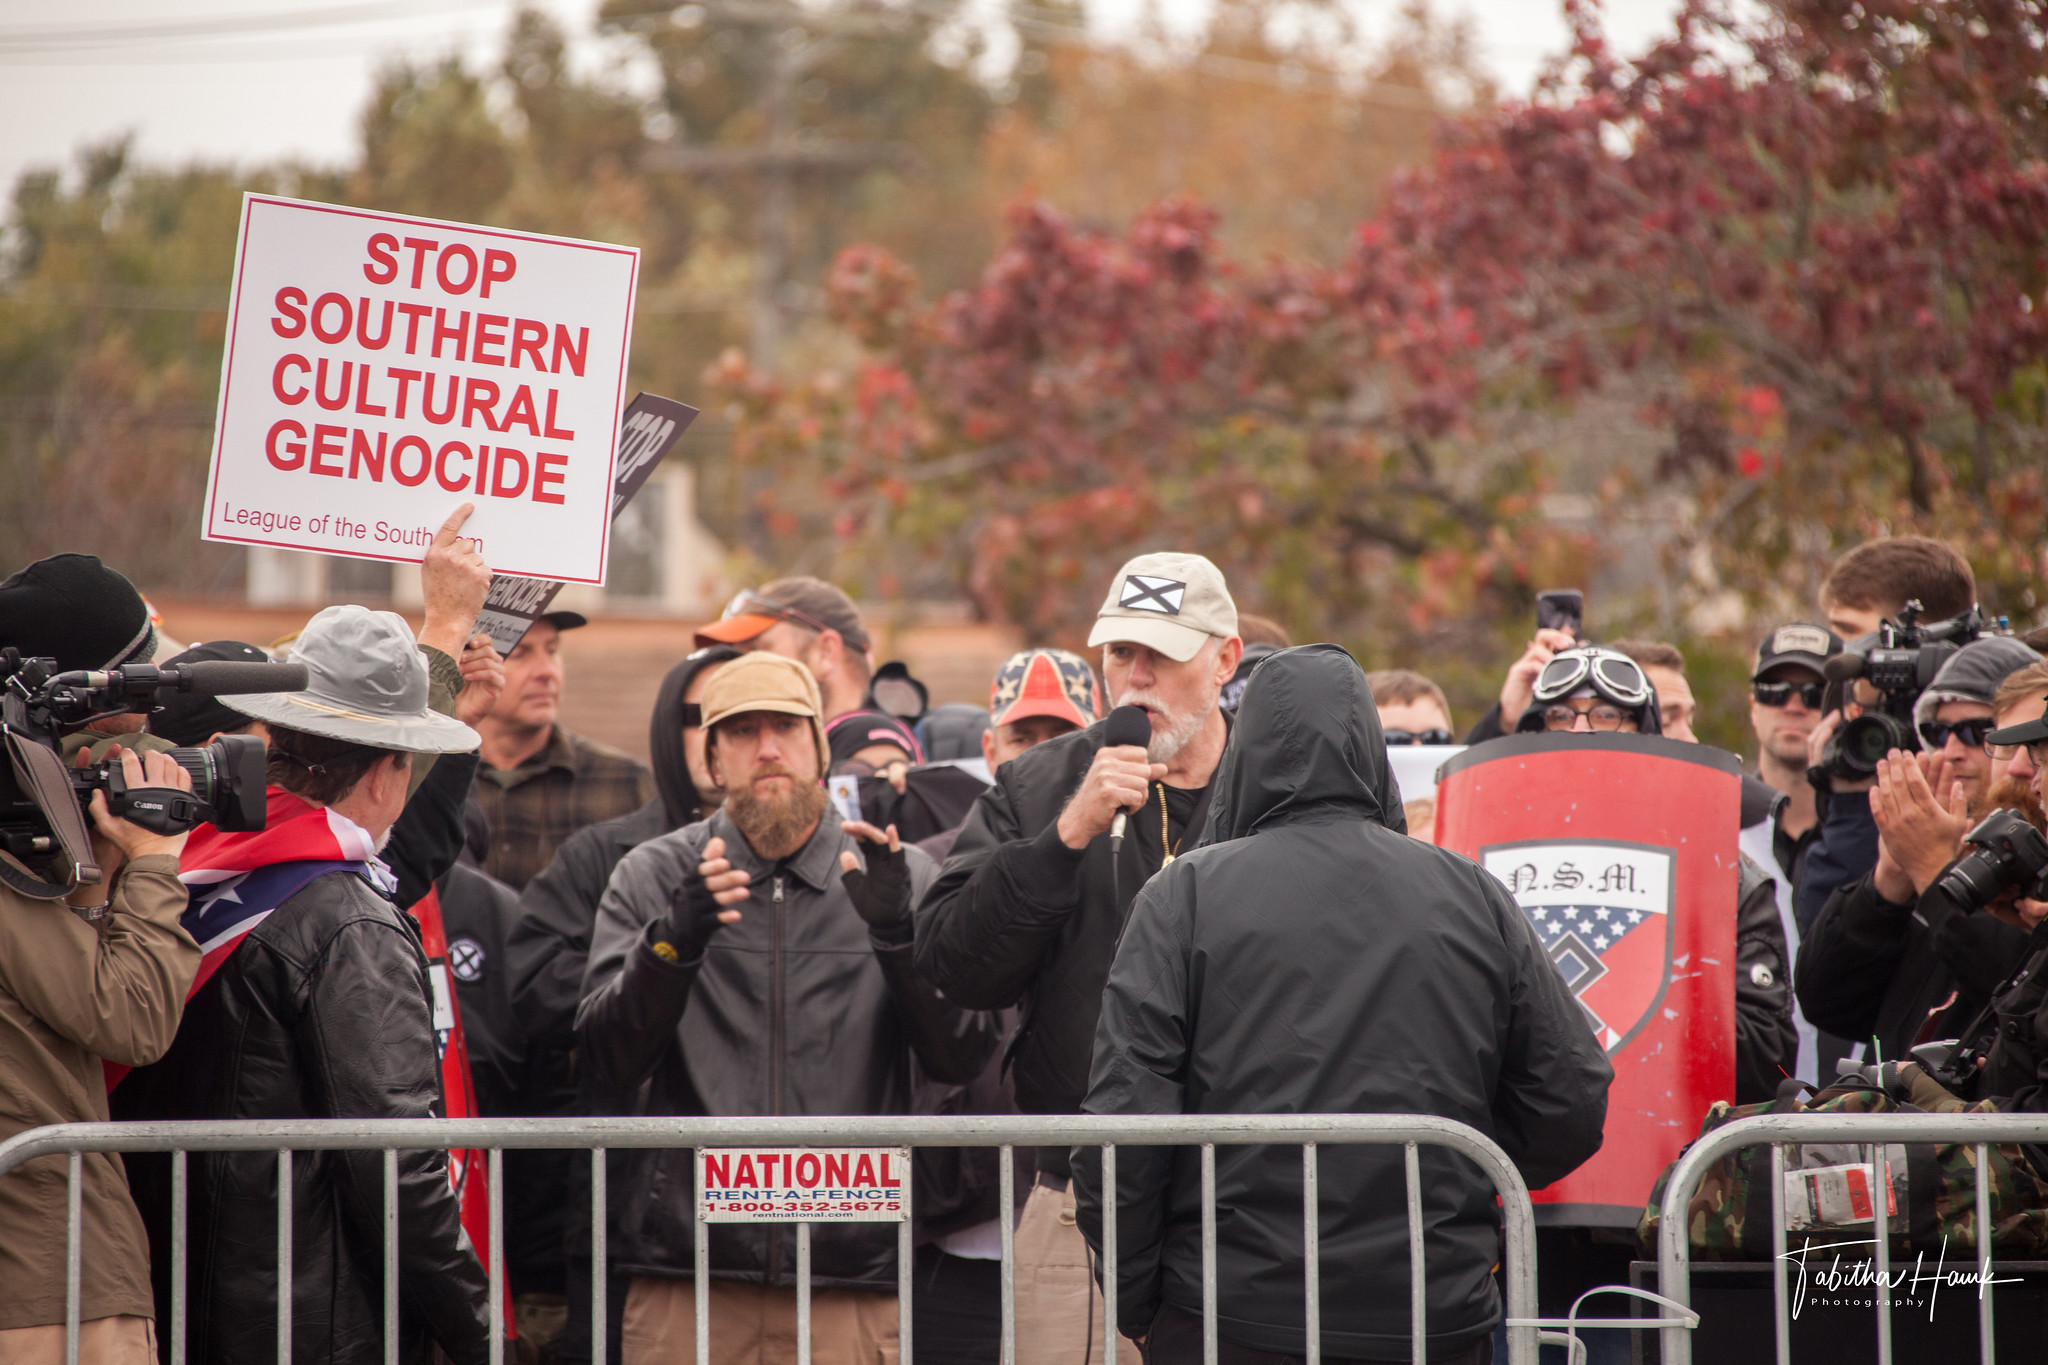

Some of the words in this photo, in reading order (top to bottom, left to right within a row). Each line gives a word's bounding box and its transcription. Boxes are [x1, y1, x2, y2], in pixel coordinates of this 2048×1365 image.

[363, 233, 517, 299] STOP
[271, 286, 590, 377] SOUTHERN
[272, 353, 575, 441] CULTURAL
[265, 419, 569, 505] GENOCIDE
[223, 502, 301, 533] League
[308, 515, 330, 534] of
[335, 517, 367, 539] the
[134, 801, 163, 811] Canon
[705, 1153, 901, 1189] NATIONAL
[705, 1190, 901, 1200] RENT-A-FENCE
[705, 1202, 901, 1212] 1-800-352-5675
